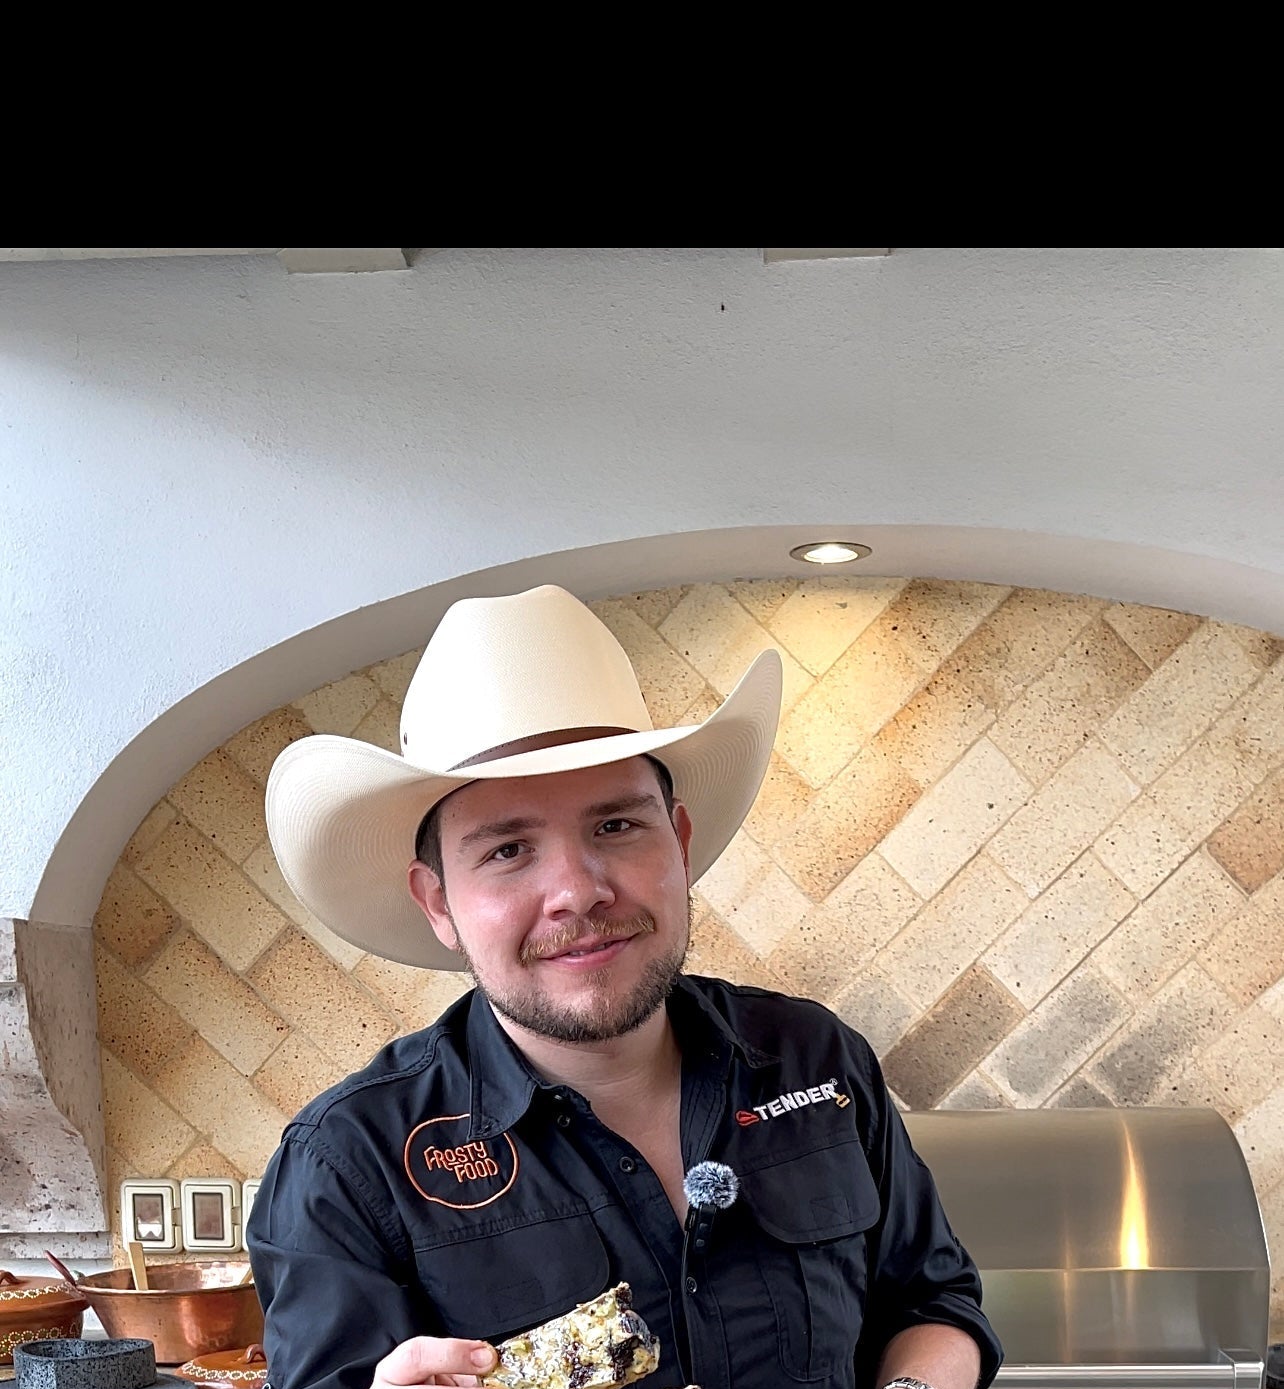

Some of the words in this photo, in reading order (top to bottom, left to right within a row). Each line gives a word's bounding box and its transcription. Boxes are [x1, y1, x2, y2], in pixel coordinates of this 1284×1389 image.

[753, 1083, 837, 1120] TENDER
[423, 1141, 487, 1171] FROSTY
[454, 1157, 499, 1183] FOOD
